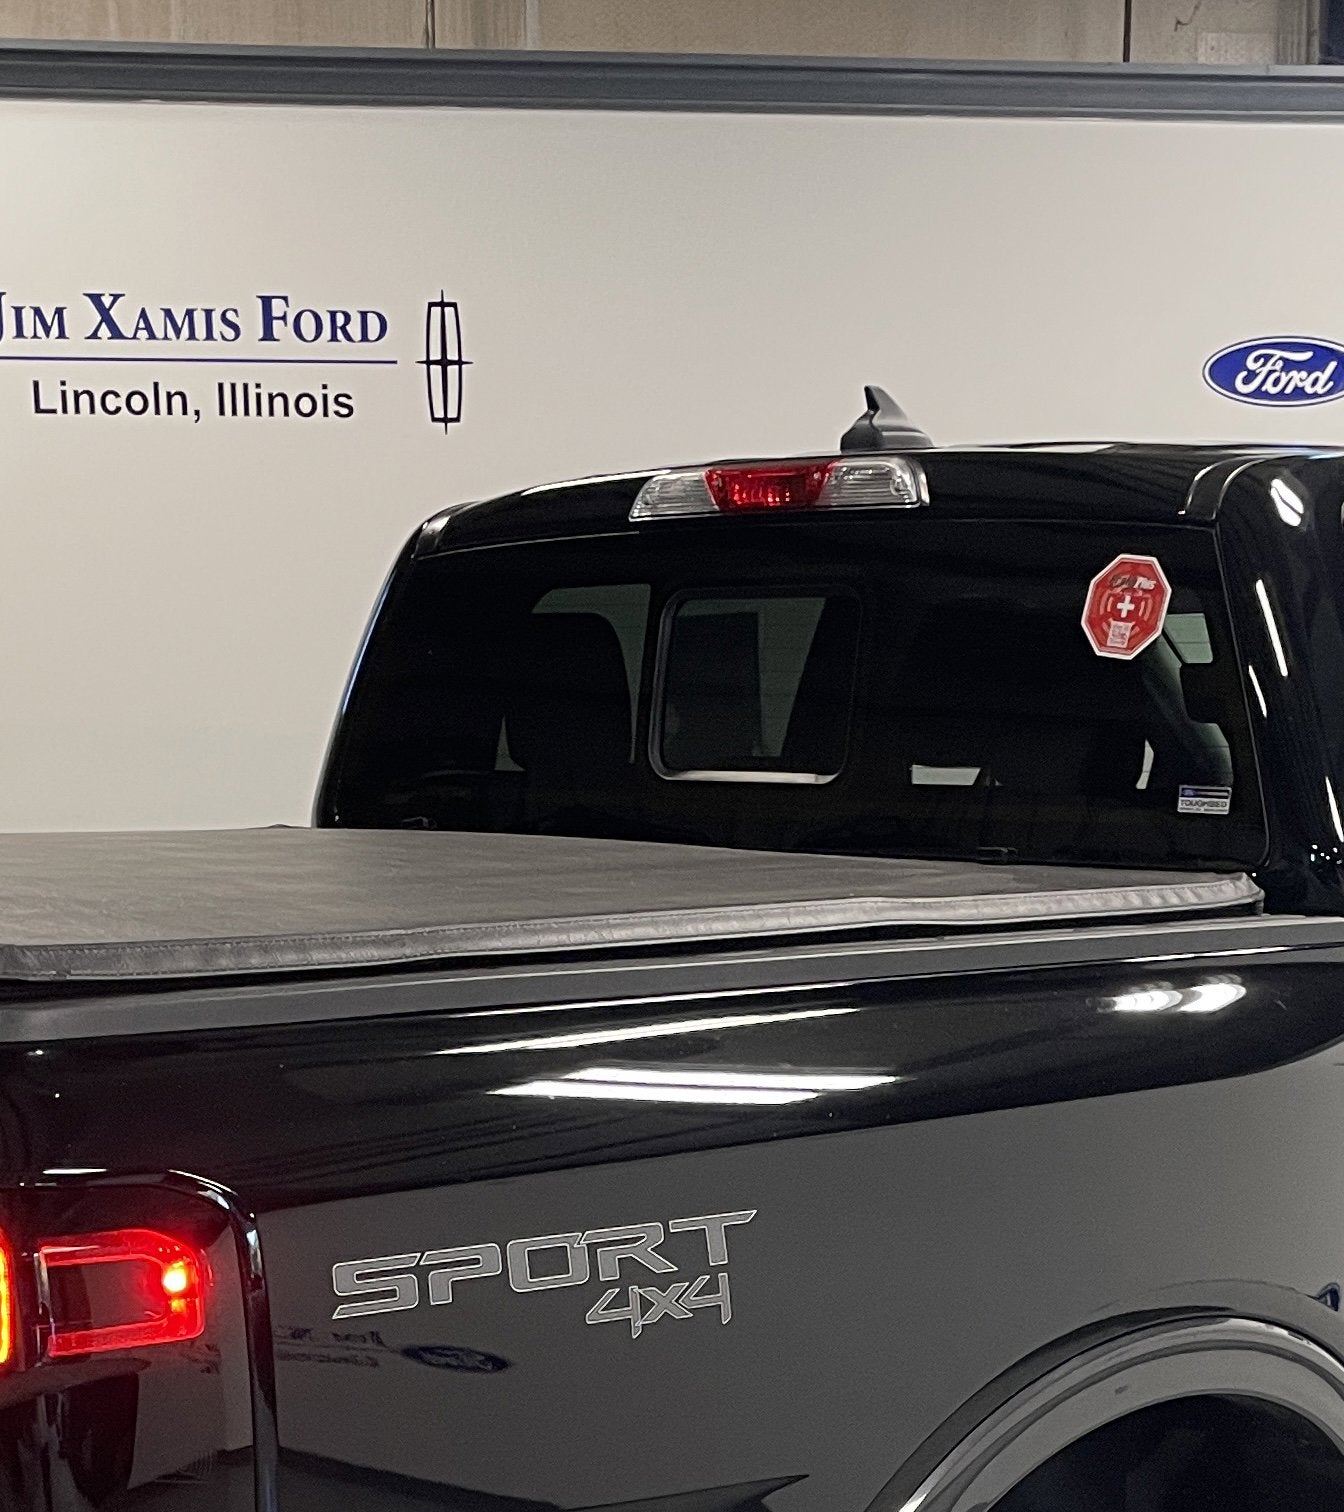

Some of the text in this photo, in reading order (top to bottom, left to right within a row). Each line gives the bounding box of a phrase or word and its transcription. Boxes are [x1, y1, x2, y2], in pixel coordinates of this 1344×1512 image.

[83, 292, 241, 343] XAMIS
[256, 294, 388, 344] FORD
[1234, 348, 1335, 396] Ford
[32, 380, 355, 424] Lincoln, Illinois
[332, 1209, 758, 1319] SPORT
